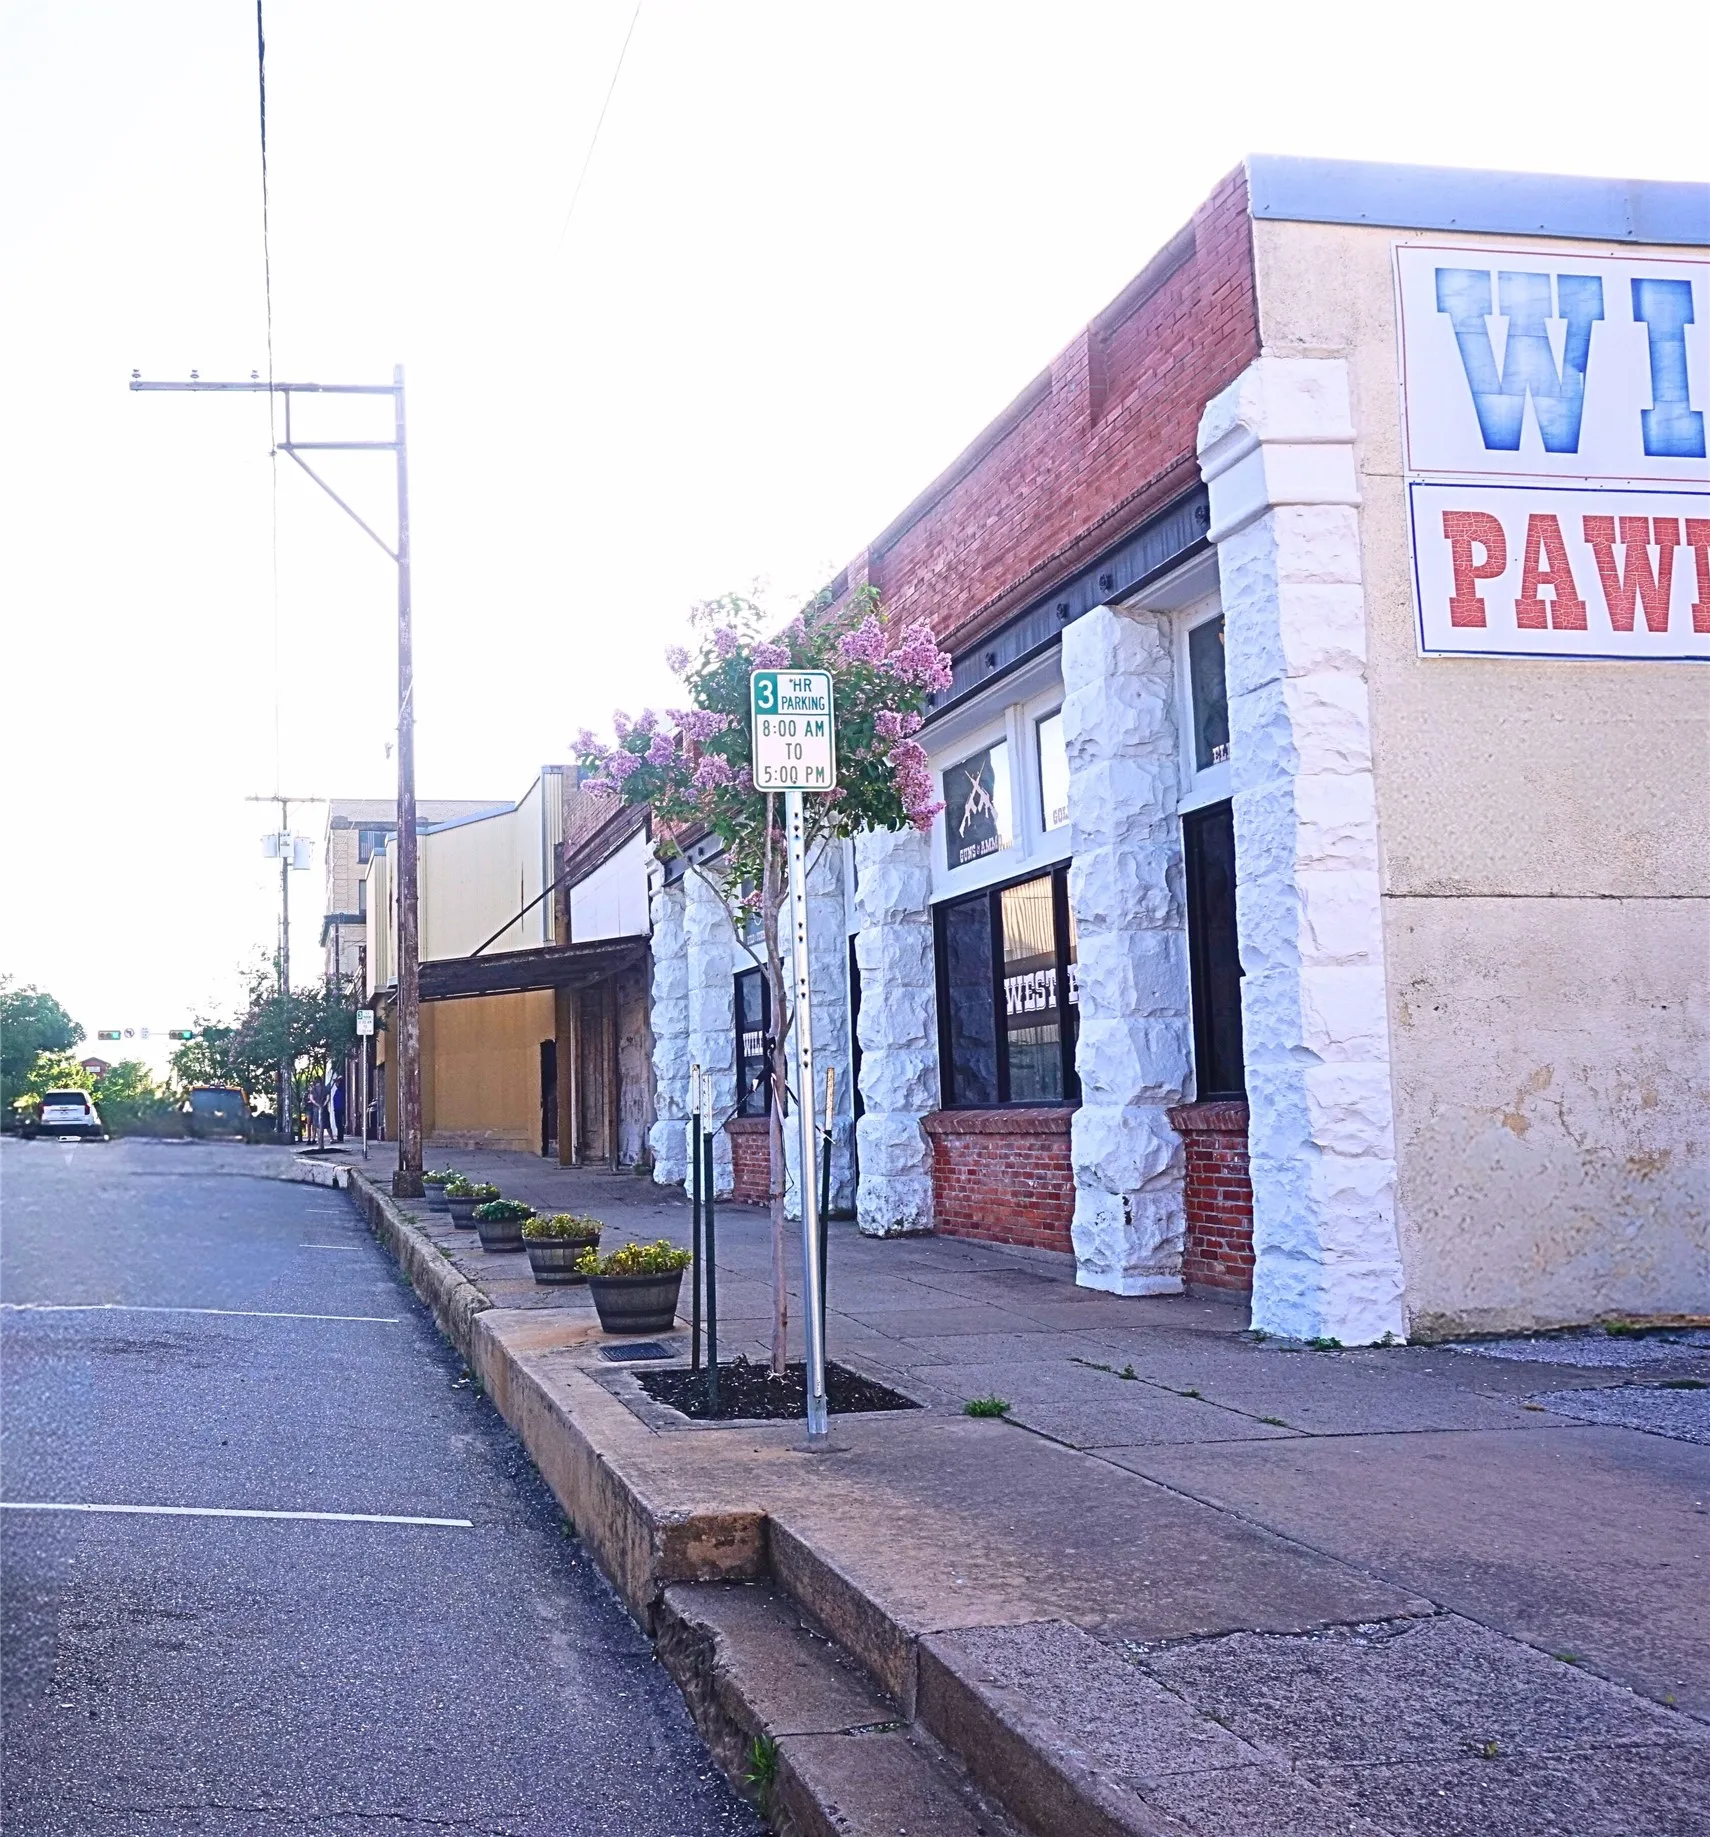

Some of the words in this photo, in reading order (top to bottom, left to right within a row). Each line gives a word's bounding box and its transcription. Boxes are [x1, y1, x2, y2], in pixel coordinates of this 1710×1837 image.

[1435, 267, 1707, 459] WI
[757, 680, 774, 709] 3
[793, 678, 812, 692] HR
[781, 696, 825, 711] PARKING
[763, 720, 796, 737] 8:00
[805, 720, 824, 737] AM
[786, 743, 802, 760] TO
[765, 766, 798, 784] 5:00
[806, 766, 825, 783] PM
[960, 844, 976, 863] GUNS
[1004, 968, 1057, 1015] WEST
